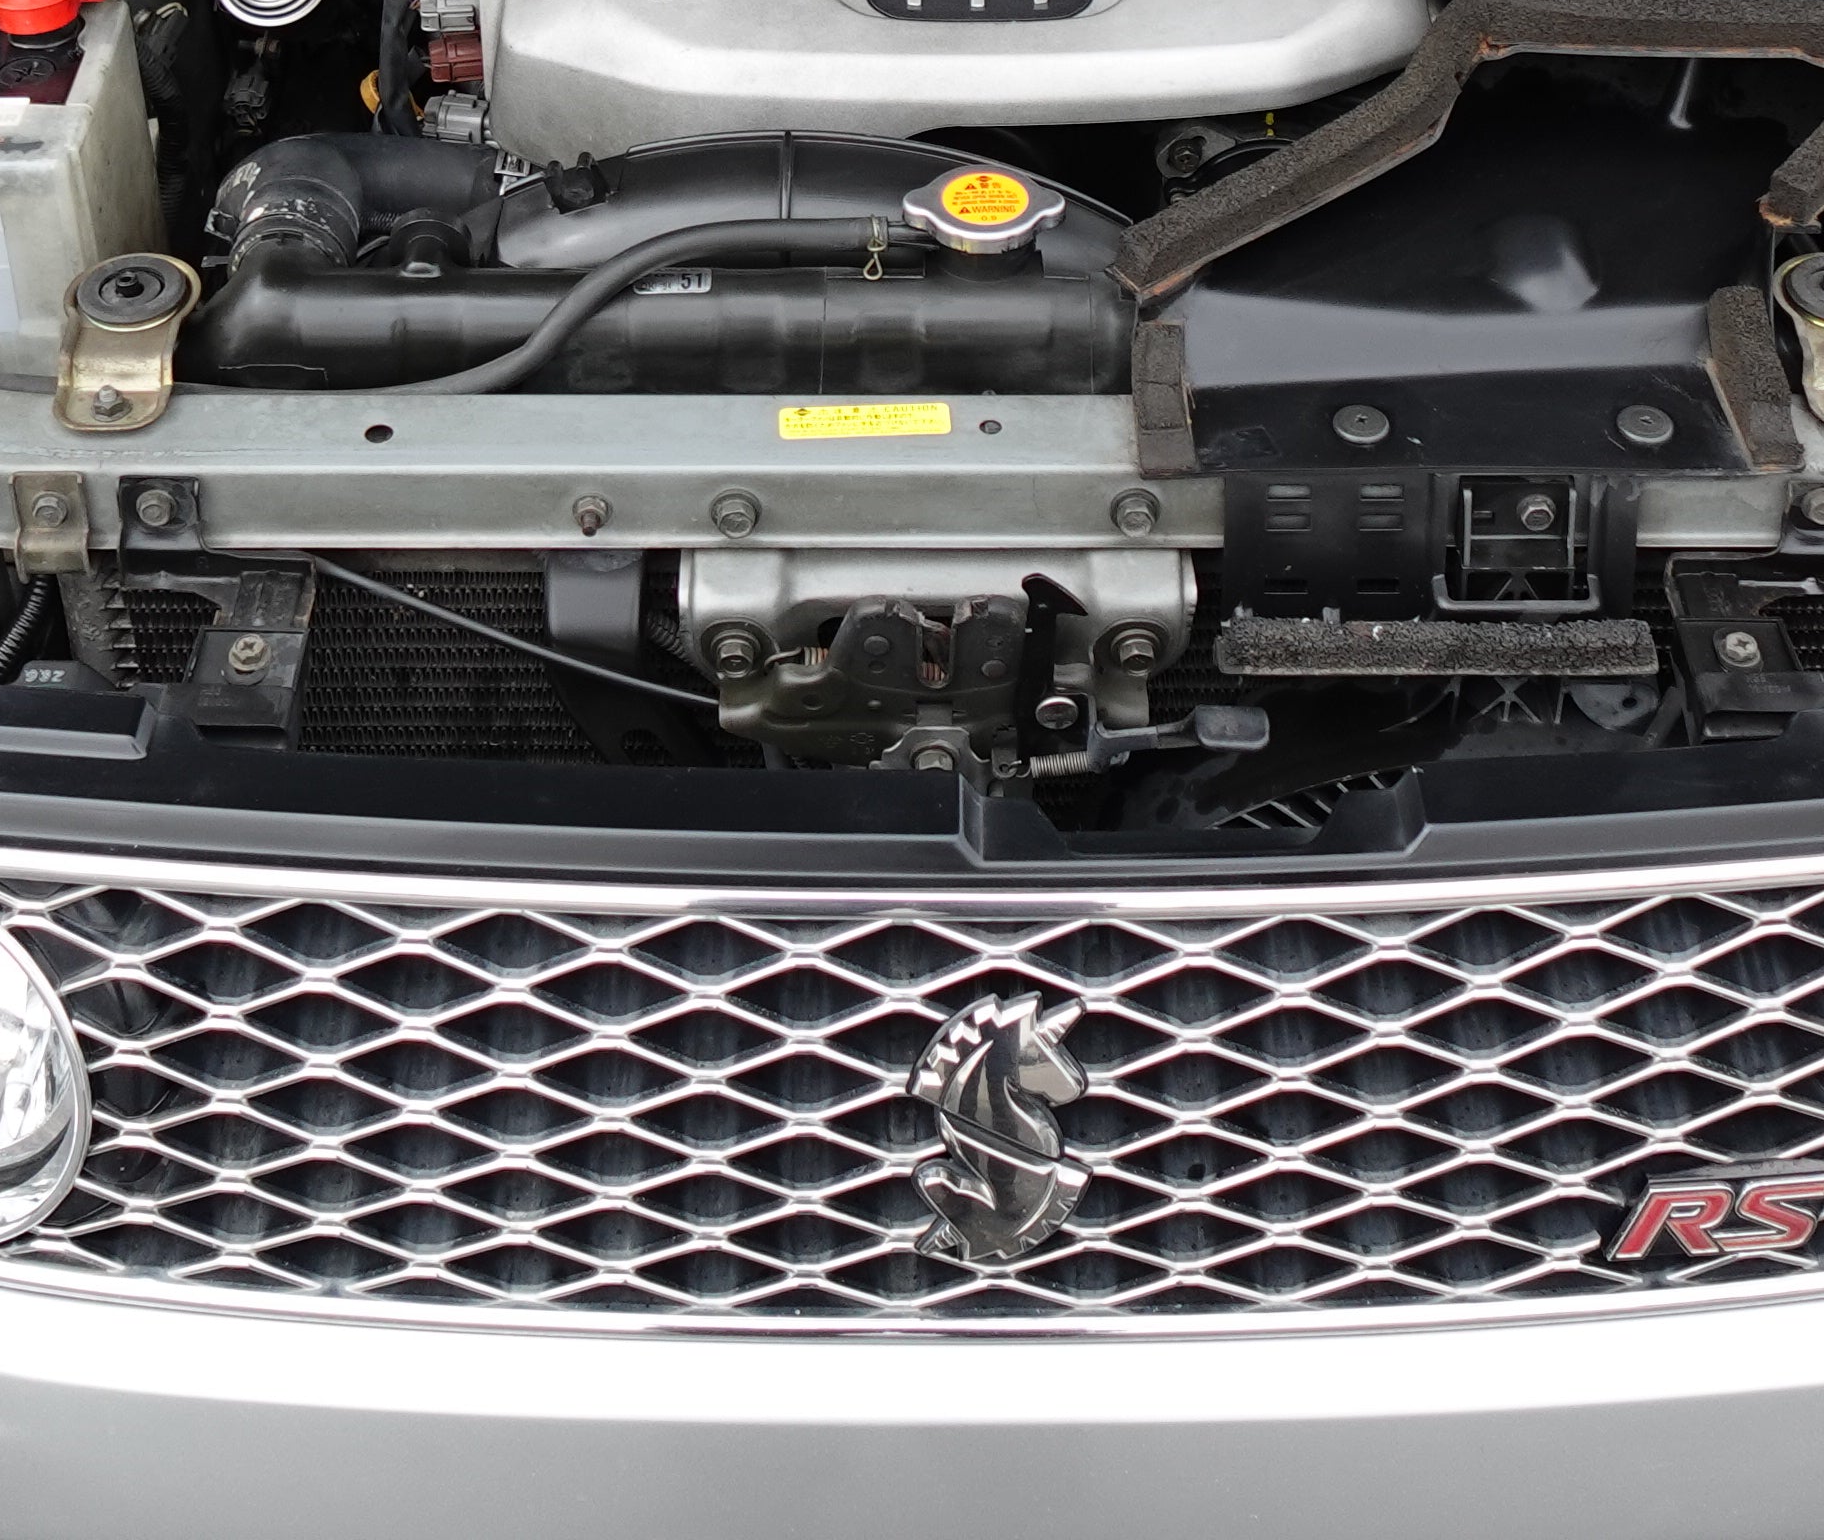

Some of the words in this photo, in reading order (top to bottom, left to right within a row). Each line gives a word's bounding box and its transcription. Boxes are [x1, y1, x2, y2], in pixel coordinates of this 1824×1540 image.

[971, 205, 1016, 213] WARNING
[680, 273, 703, 289] 51
[884, 404, 938, 413] CAUTION
